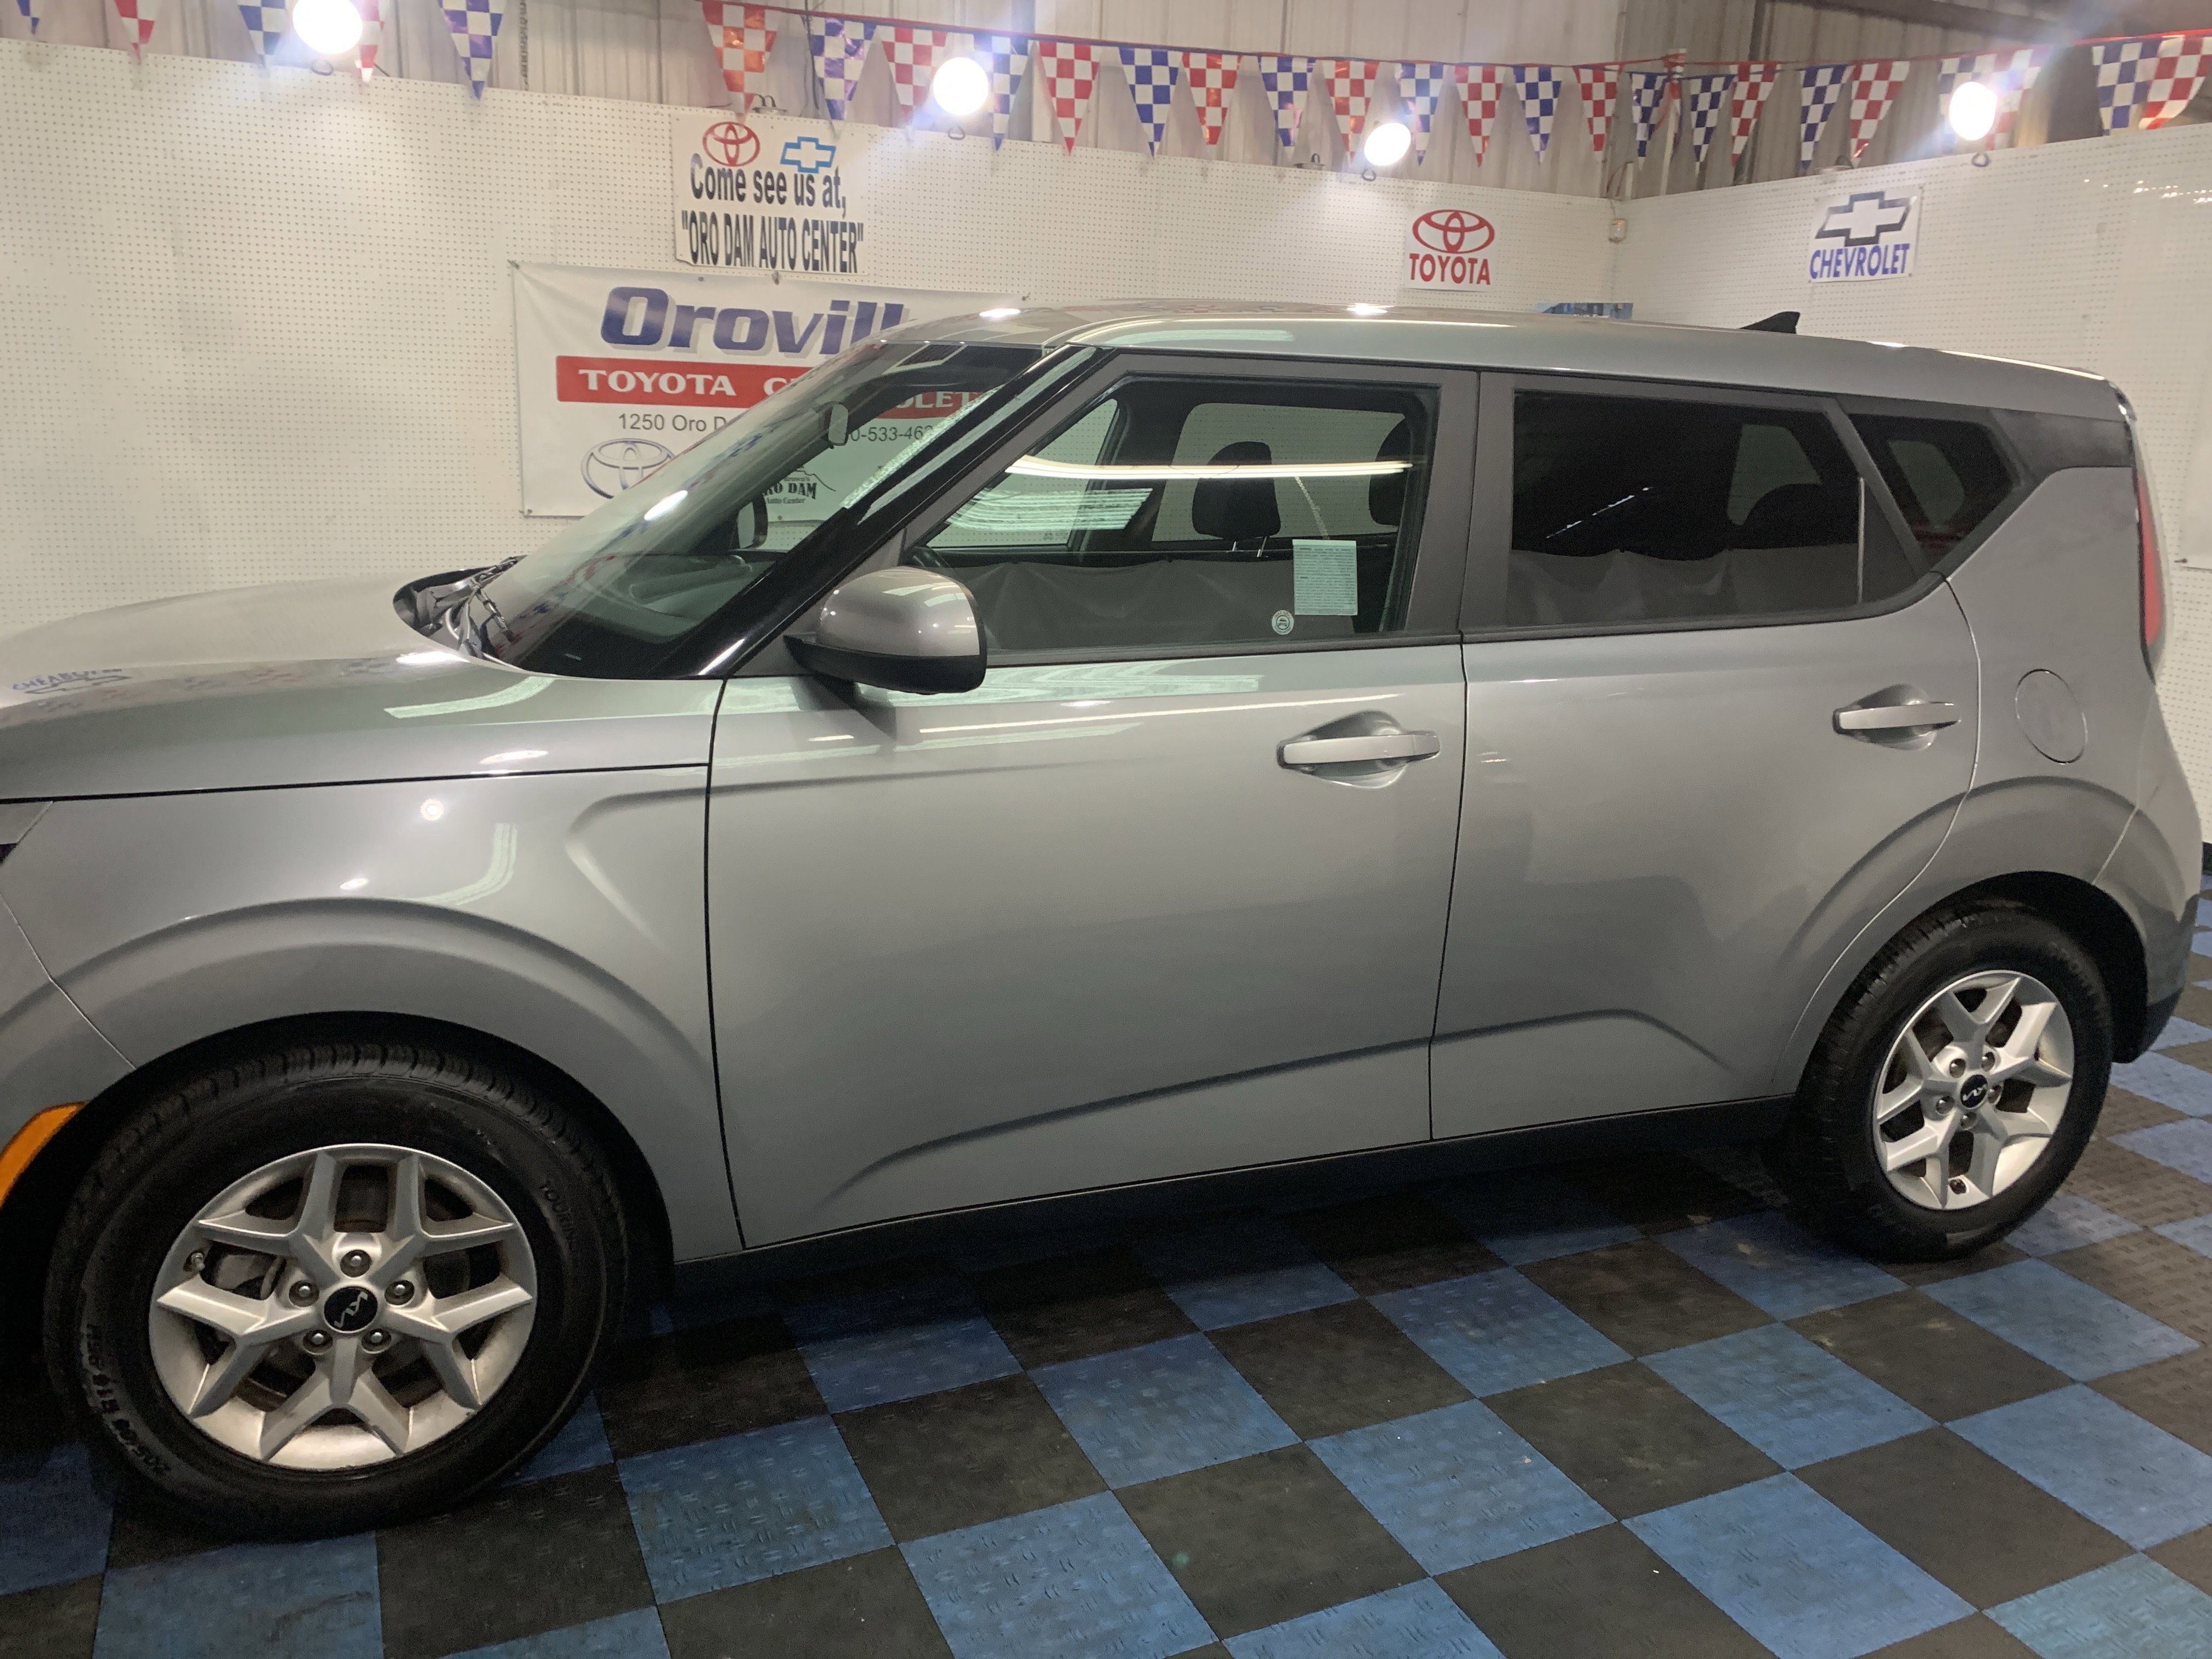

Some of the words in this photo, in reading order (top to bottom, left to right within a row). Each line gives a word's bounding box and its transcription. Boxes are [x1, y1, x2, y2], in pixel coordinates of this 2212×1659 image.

[690, 153, 746, 202] Come
[753, 170, 787, 205] see
[794, 173, 816, 207] us
[822, 166, 847, 219] at,
[681, 210, 719, 266] "ORO
[724, 213, 754, 267] DAM
[759, 216, 797, 270] AUTO
[802, 218, 864, 274] CENTER"
[1409, 253, 1491, 286] TOYOTA
[1809, 242, 1911, 279] CHEVROLET
[578, 369, 737, 396] TOYOTA
[618, 413, 665, 431] 1250
[672, 414, 707, 432] Oro
[788, 482, 817, 500] DAM
